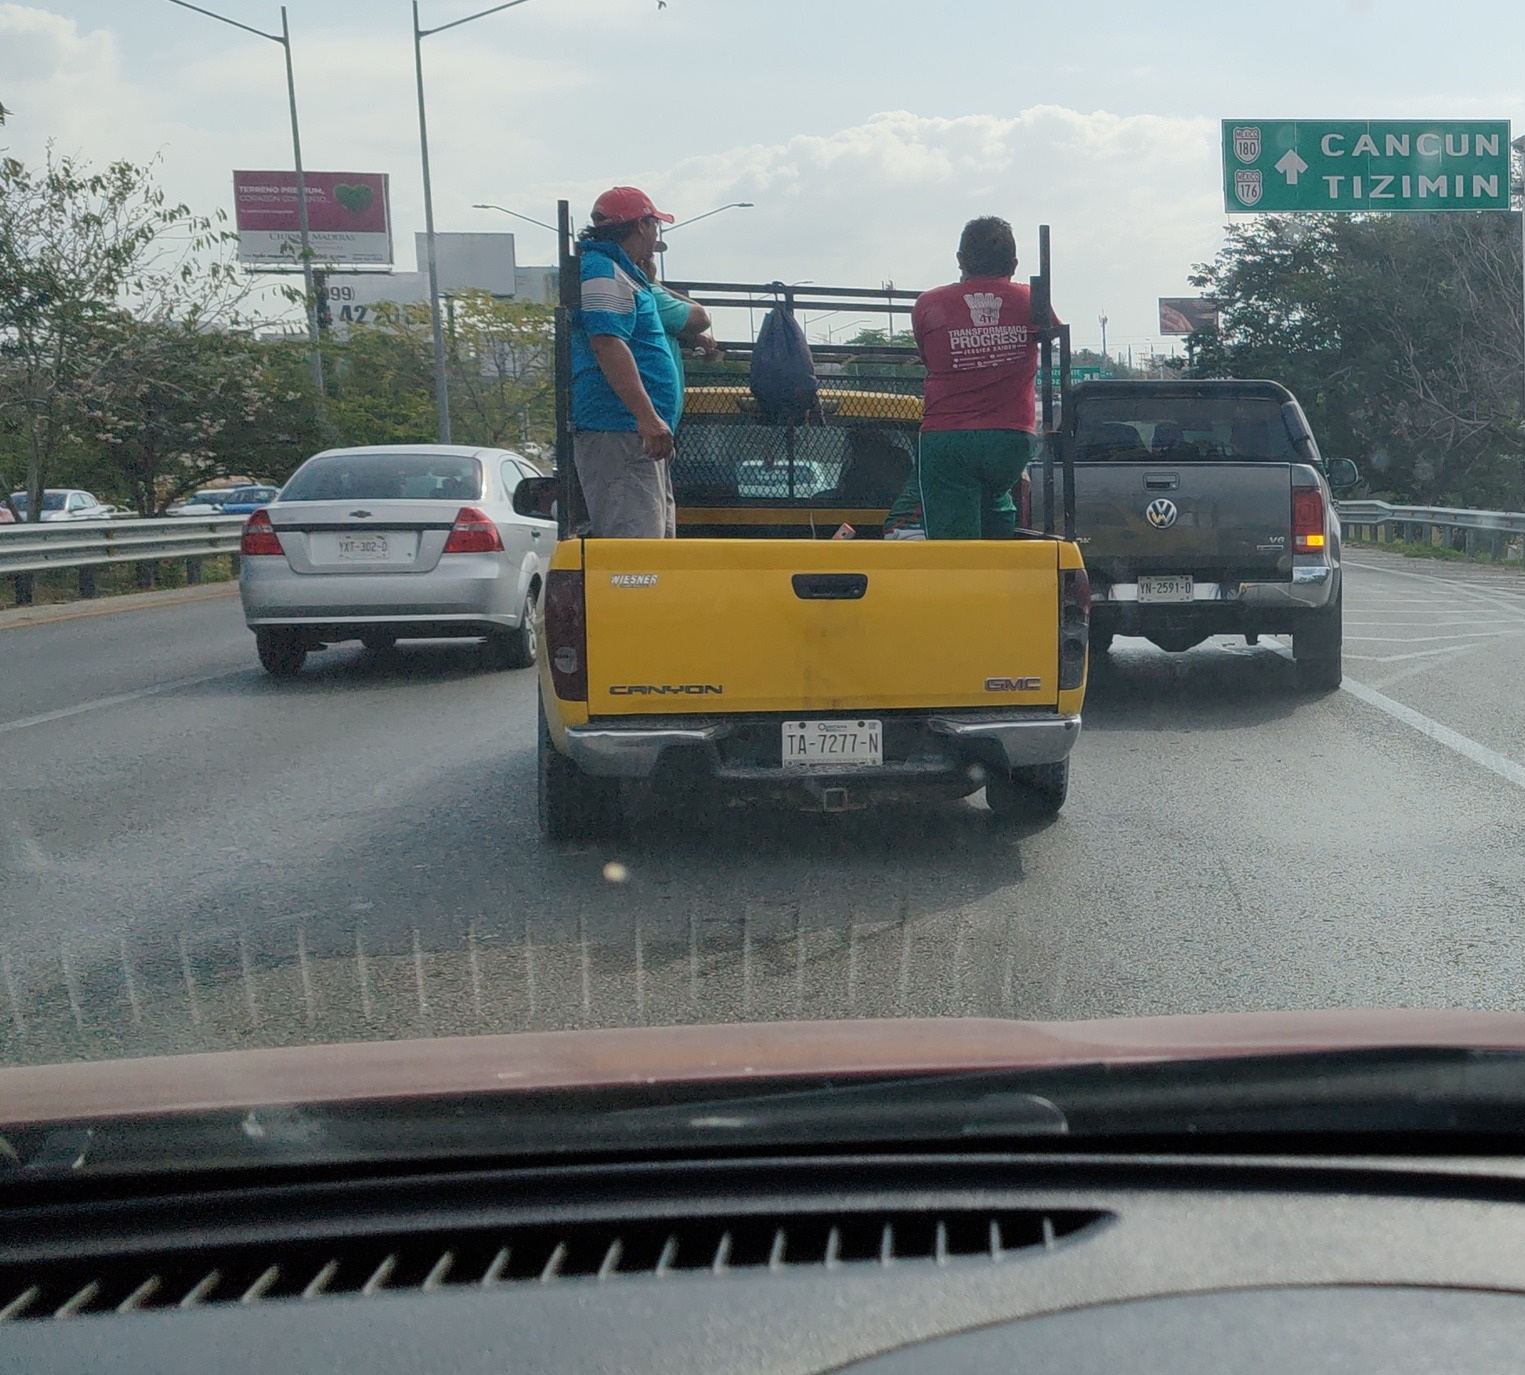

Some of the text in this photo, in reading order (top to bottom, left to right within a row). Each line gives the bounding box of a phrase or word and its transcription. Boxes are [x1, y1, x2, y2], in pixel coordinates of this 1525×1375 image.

[1239, 141, 1257, 156] 180
[1320, 133, 1499, 157] CANCUN
[239, 185, 279, 194] TERRENO
[1241, 184, 1258, 198] 176
[1322, 174, 1499, 199] TIZIMIN
[948, 326, 1028, 338] TRANSFORMEMOS
[611, 574, 658, 585] WIESNER
[609, 685, 722, 695] CANYON
[985, 676, 1041, 692] GMC
[787, 733, 878, 755] TA-7277-N
